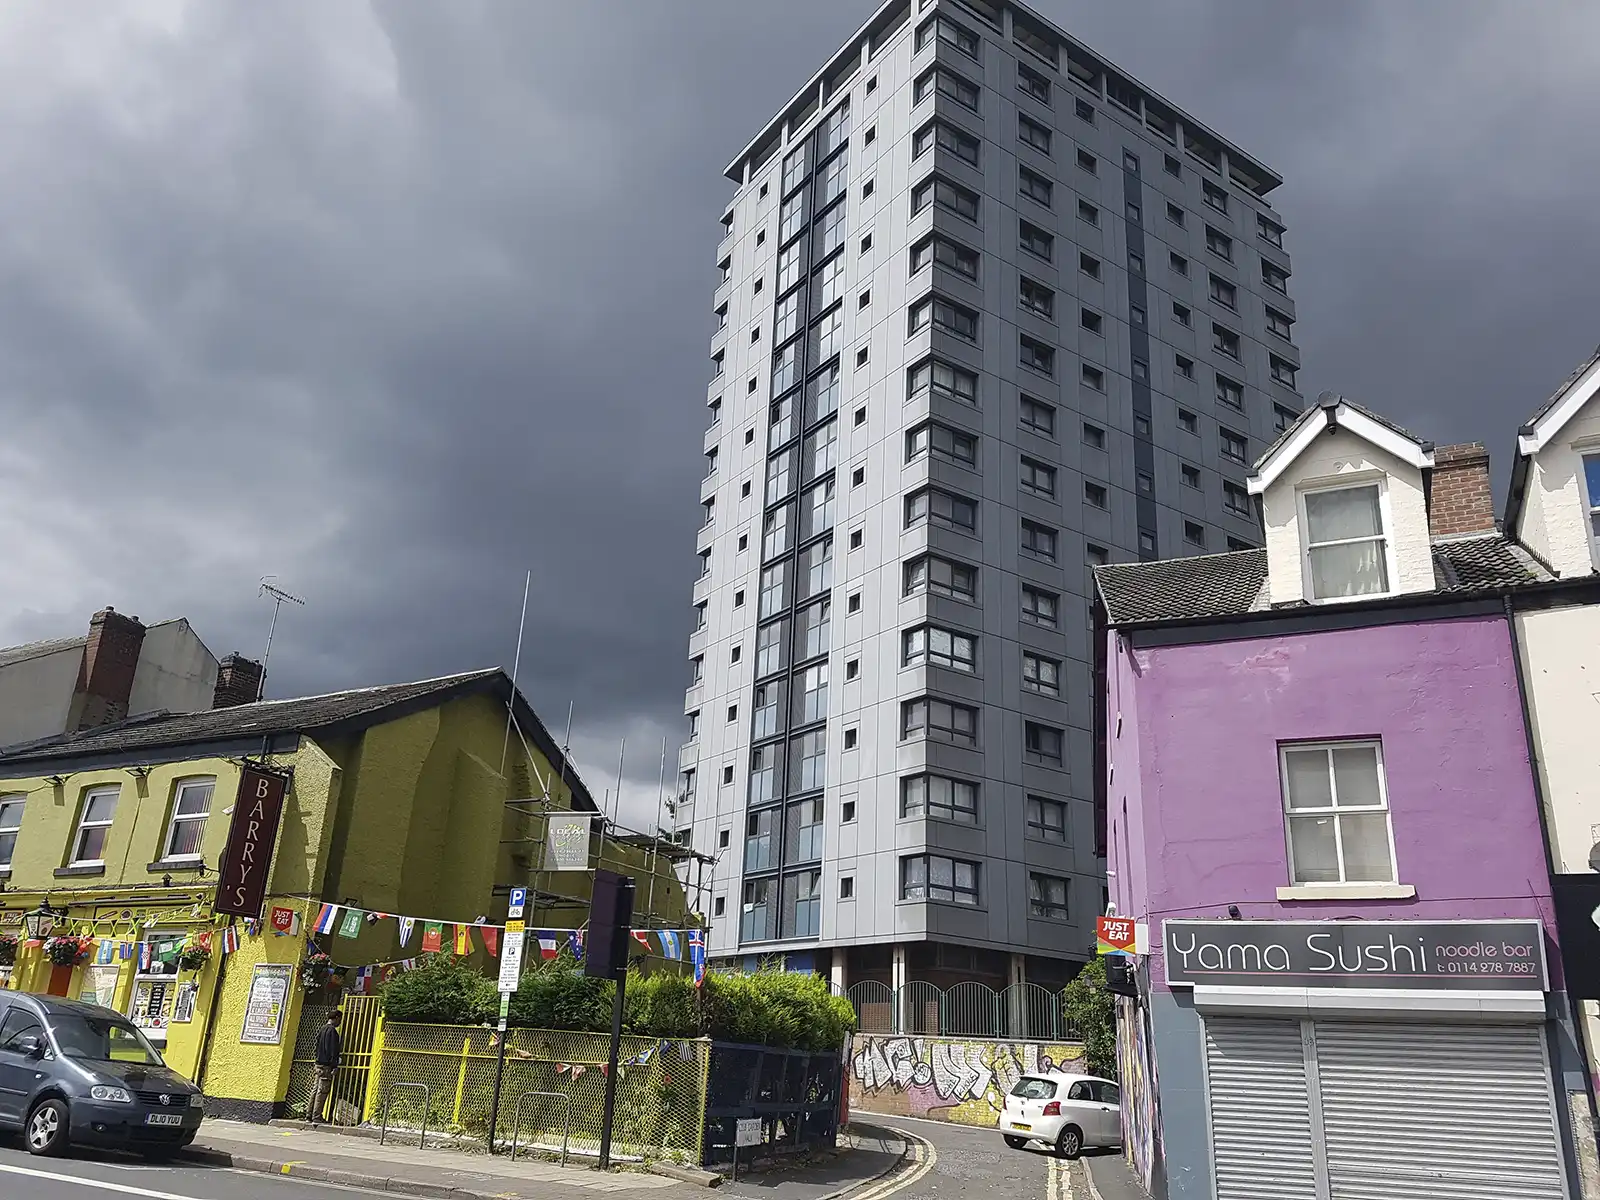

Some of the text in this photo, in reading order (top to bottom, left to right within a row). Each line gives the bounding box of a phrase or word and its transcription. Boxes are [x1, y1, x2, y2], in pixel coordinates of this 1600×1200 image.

[227, 778, 269, 907] BARRY'S
[512, 890, 523, 905] P
[274, 910, 290, 918] JUST
[276, 917, 289, 925] EAT
[1103, 921, 1129, 931] JUST
[1108, 931, 1129, 940] EAT
[1172, 933, 1427, 972] Yama Sushi
[1435, 942, 1533, 957] noodle bar
[1448, 962, 1478, 972] 0114
[1480, 962, 1503, 973] 278
[1505, 962, 1536, 973] 7887
